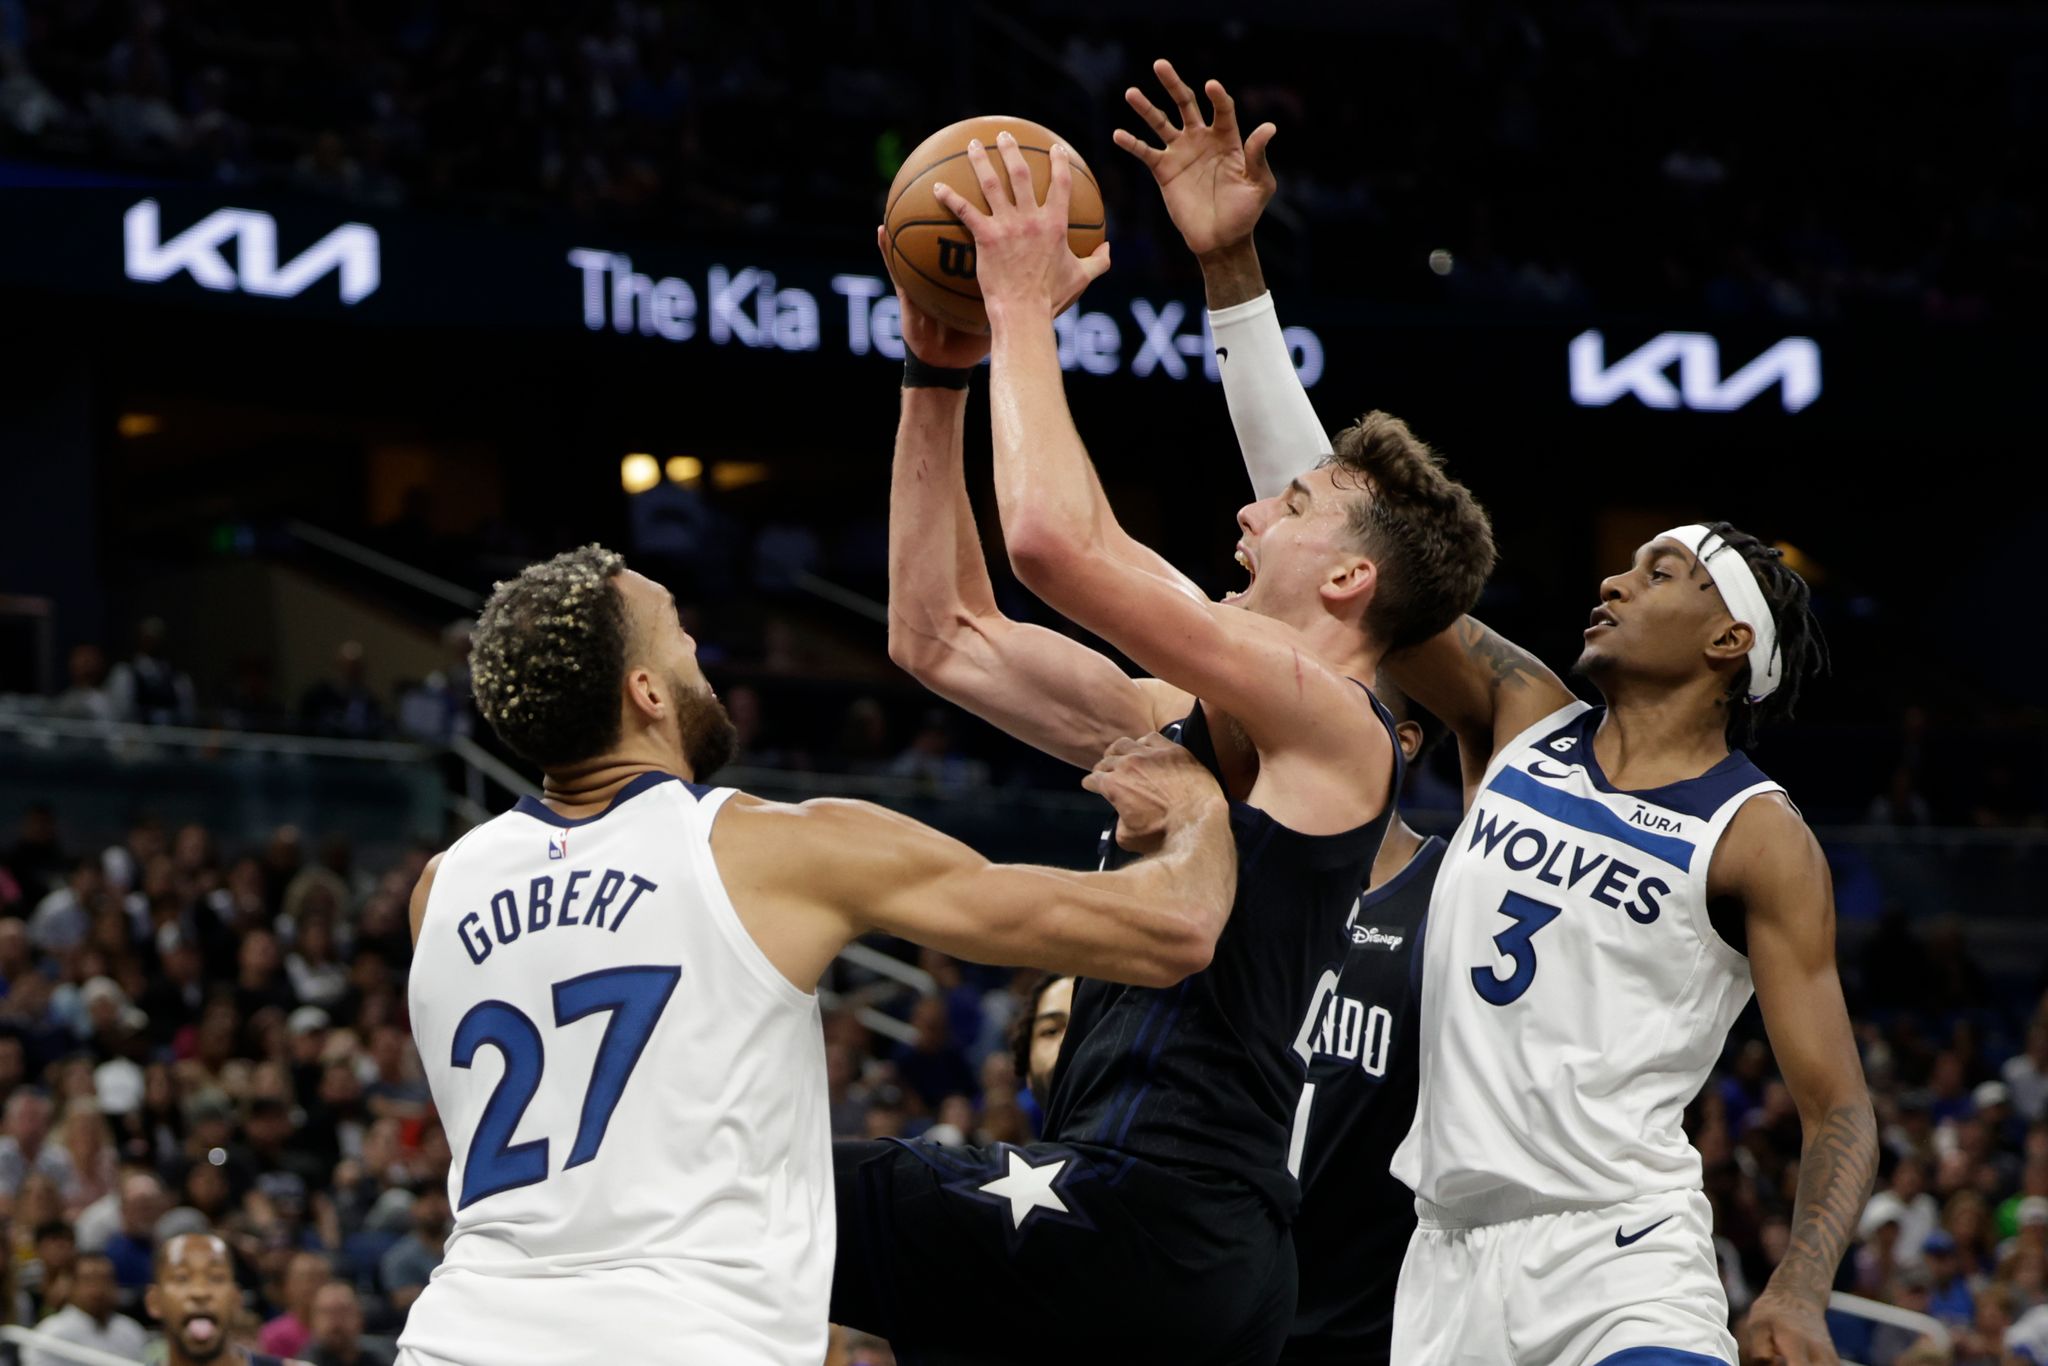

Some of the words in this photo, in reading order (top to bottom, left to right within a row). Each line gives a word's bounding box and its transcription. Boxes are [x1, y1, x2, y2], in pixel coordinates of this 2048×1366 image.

[568, 247, 697, 340] The
[707, 264, 820, 351] Kia
[1130, 296, 1325, 388] X-o
[1549, 736, 1578, 752] 6
[457, 869, 658, 965] GOBERT
[1467, 808, 1671, 924] WOLVES
[1471, 889, 1562, 1006] 3
[451, 964, 682, 1212] 27
